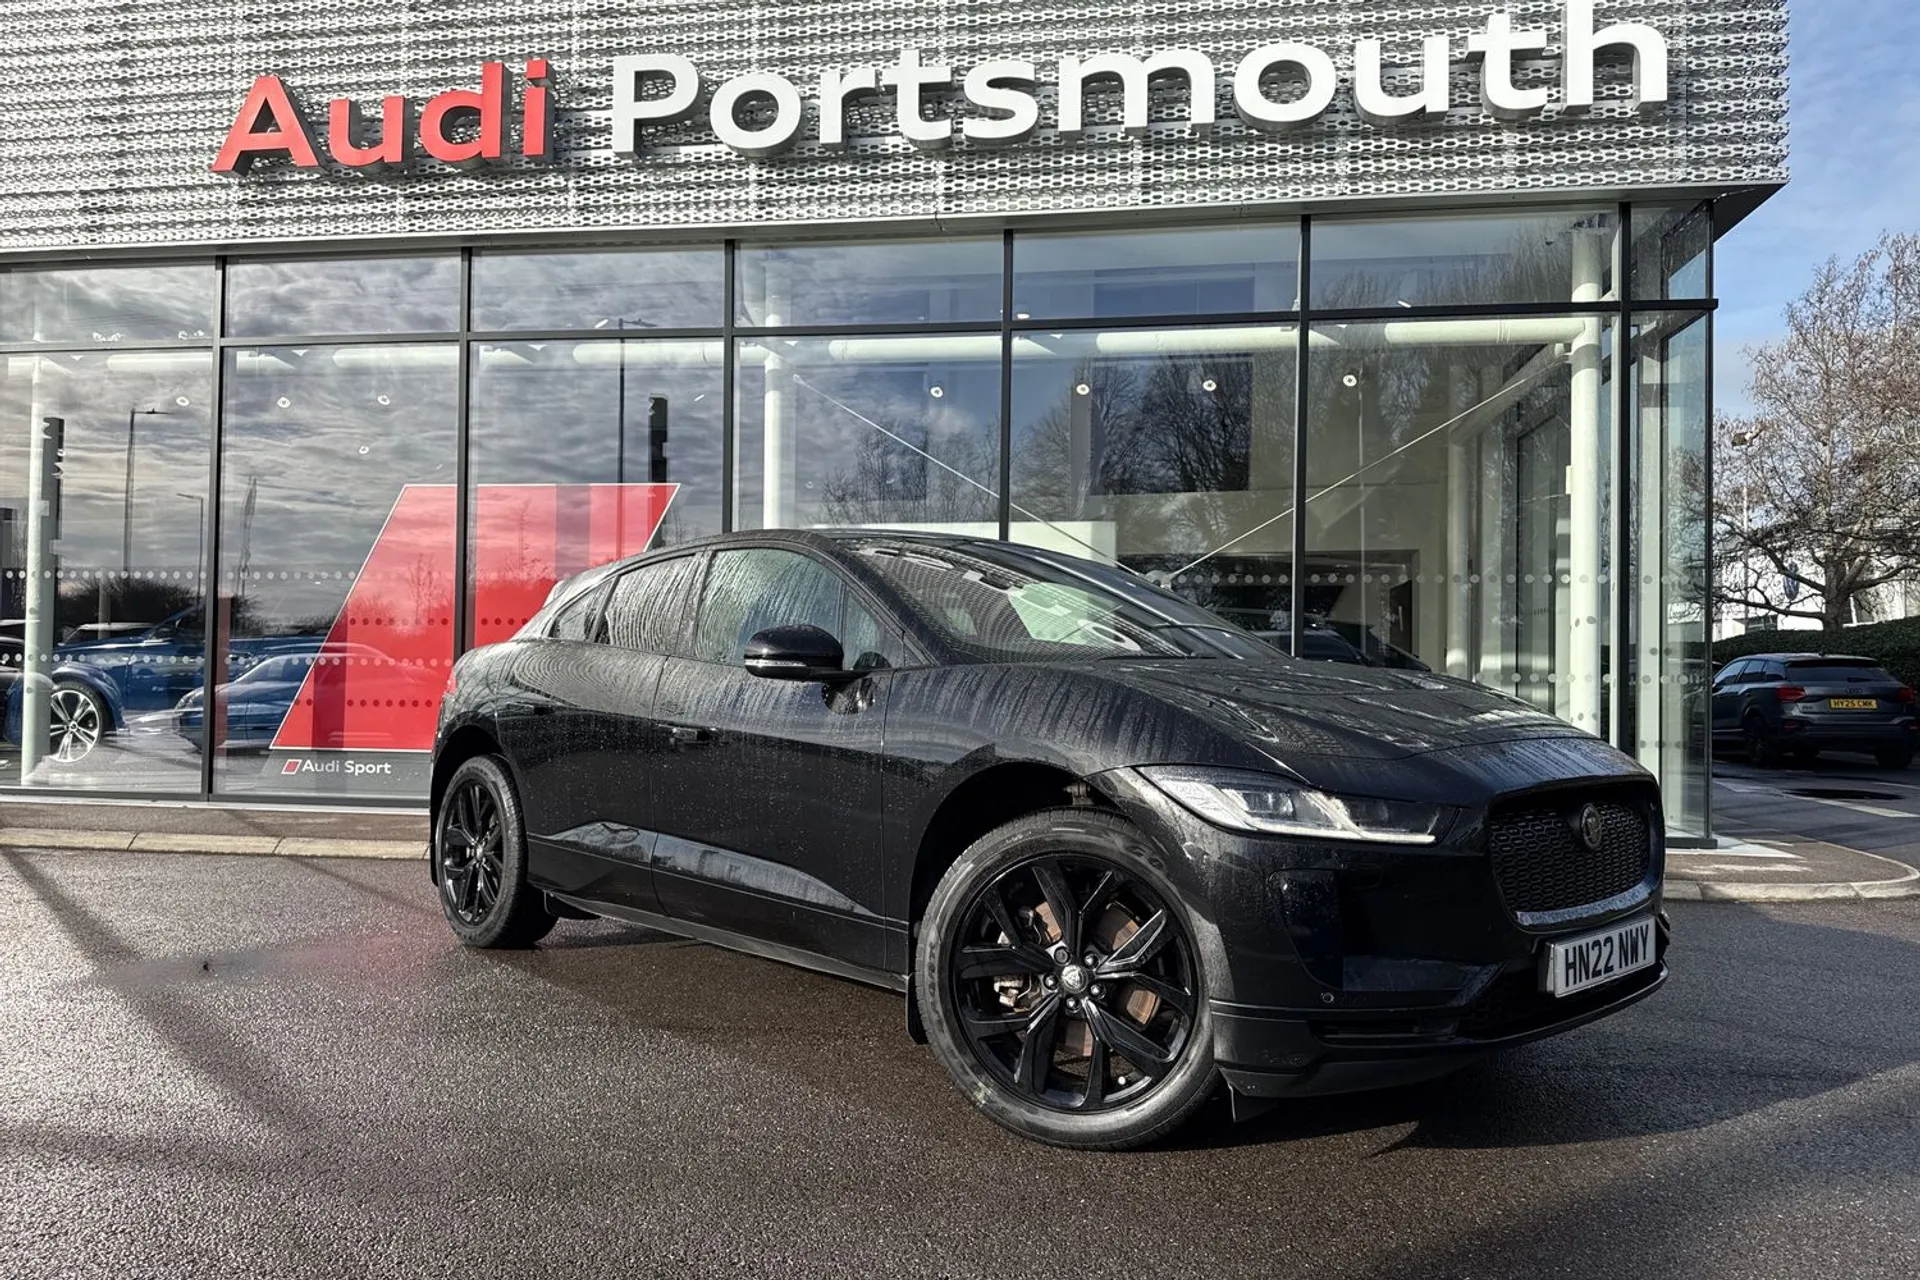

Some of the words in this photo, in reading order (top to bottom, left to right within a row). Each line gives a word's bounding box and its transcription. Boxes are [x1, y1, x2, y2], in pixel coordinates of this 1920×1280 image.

[211, 59, 549, 171] Audi
[610, 0, 1667, 154] Portsmouth
[302, 760, 340, 772] Audi
[344, 760, 392, 776] Sport
[1565, 936, 1614, 988] HN22
[1618, 924, 1649, 969] NWY
